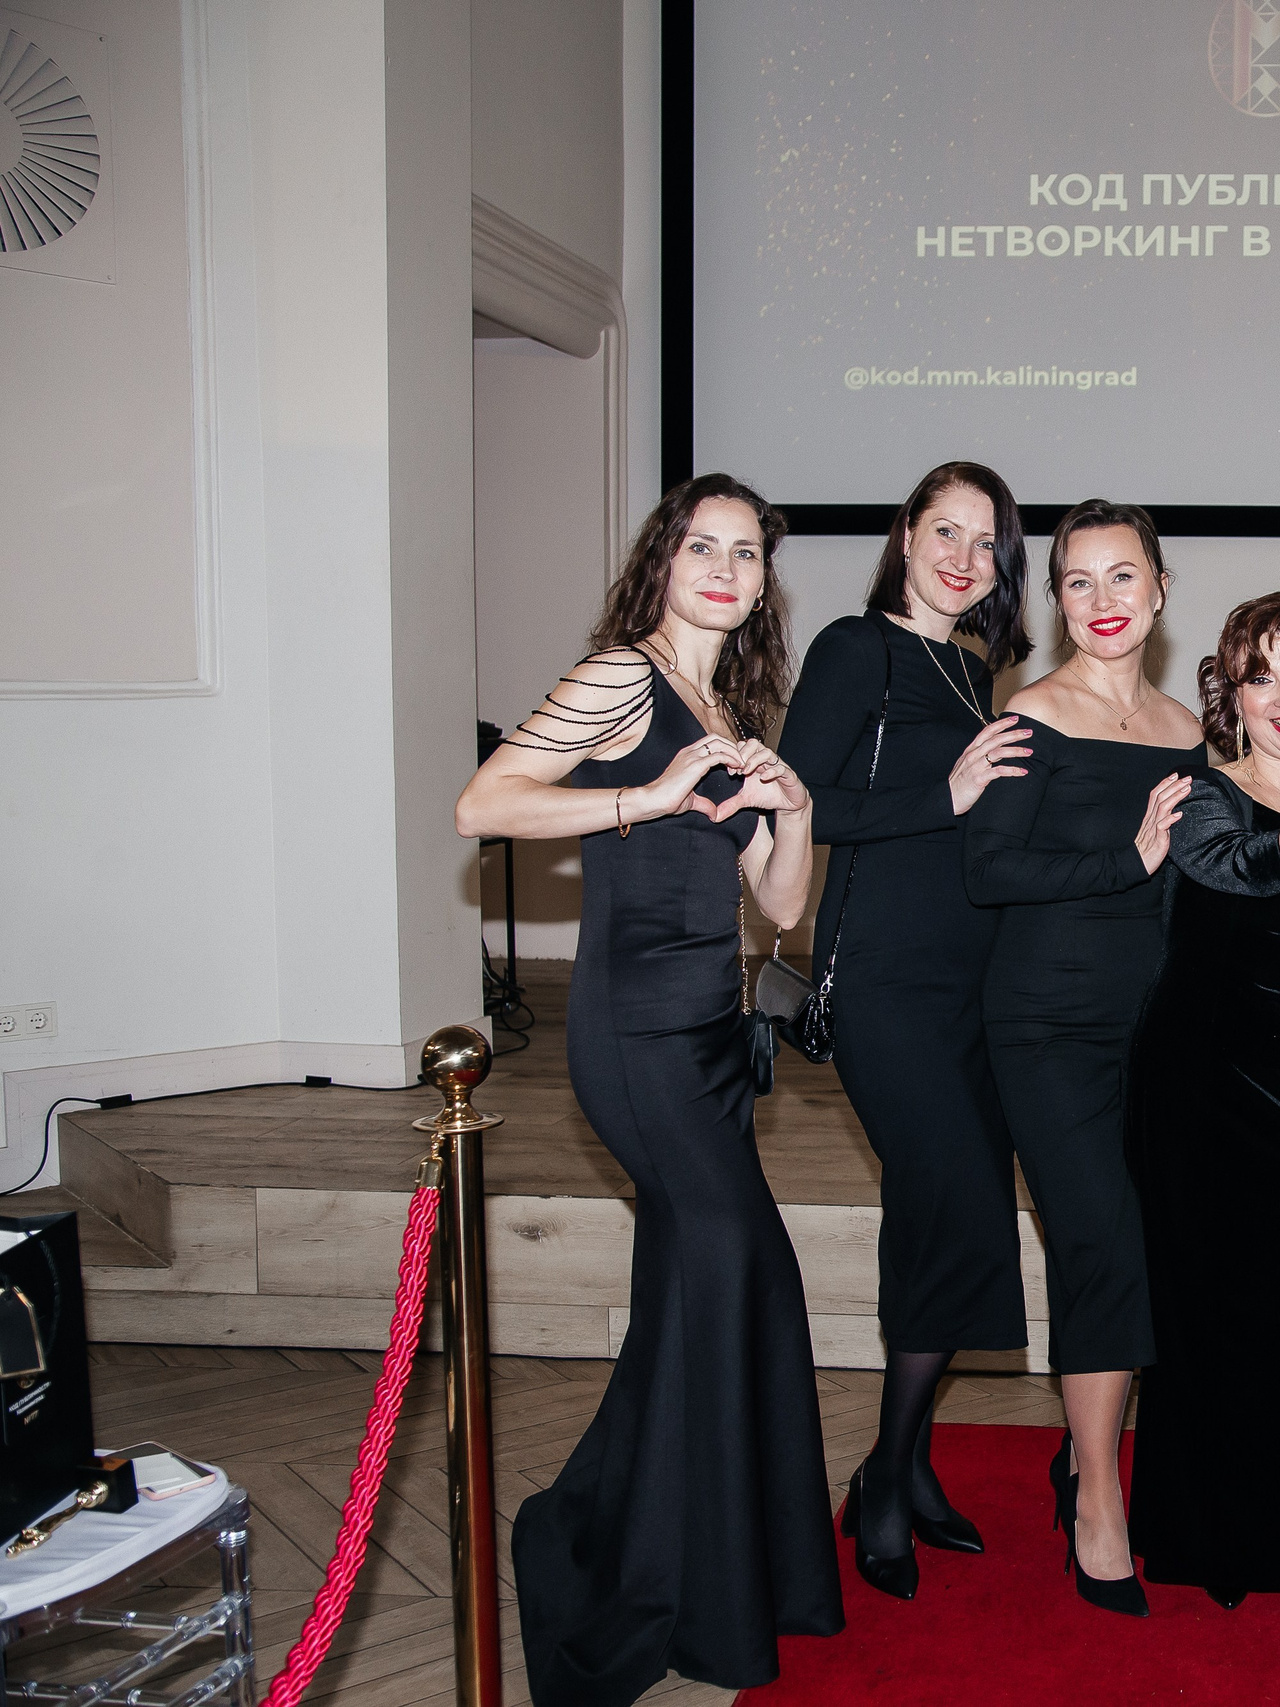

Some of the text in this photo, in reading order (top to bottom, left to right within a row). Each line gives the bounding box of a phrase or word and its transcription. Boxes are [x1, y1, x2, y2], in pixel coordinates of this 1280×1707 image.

[1029, 173, 1127, 211] КОД
[917, 225, 1228, 258] НЕТВОРКИНГ
[1243, 226, 1271, 257] В
[844, 365, 1138, 391] @kod.mm.kaliningrad
